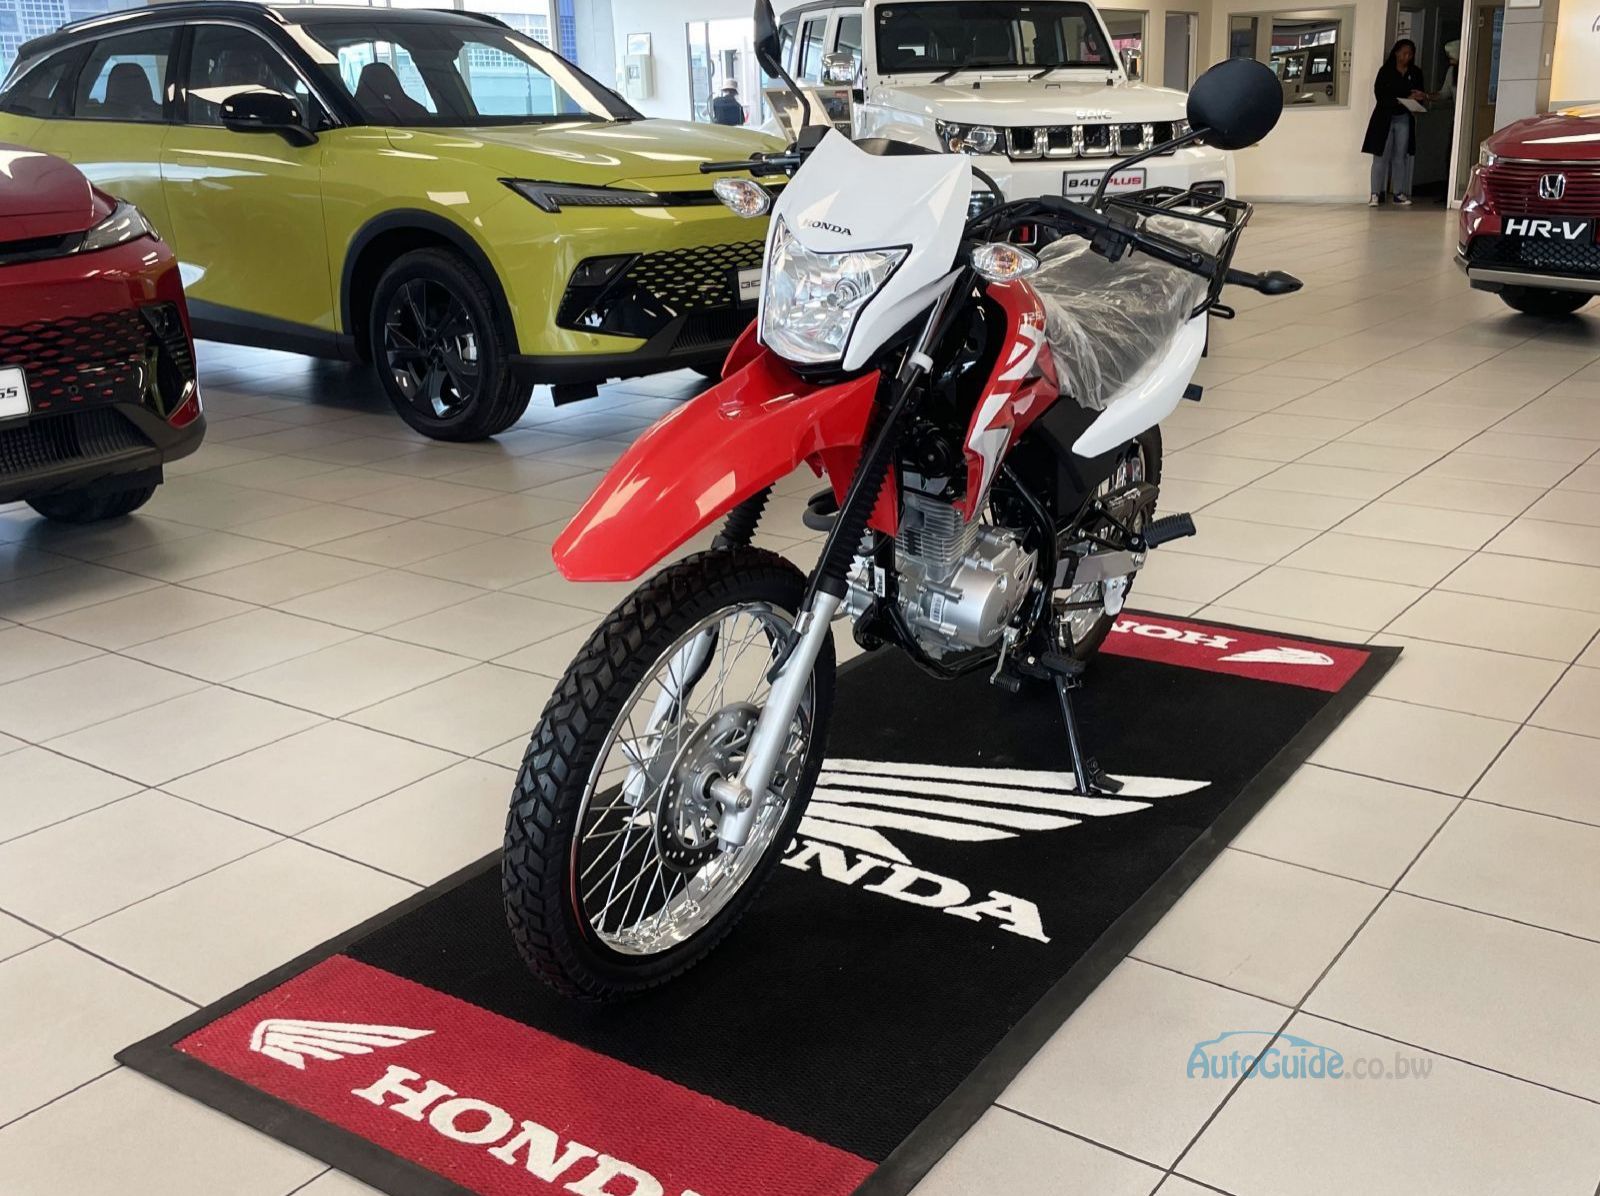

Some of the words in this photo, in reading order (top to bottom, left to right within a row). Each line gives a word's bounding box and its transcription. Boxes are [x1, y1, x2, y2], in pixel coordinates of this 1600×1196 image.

[1068, 178, 1100, 188] B40
[1505, 218, 1588, 240] HR-V
[351, 1064, 702, 1196] HOND
